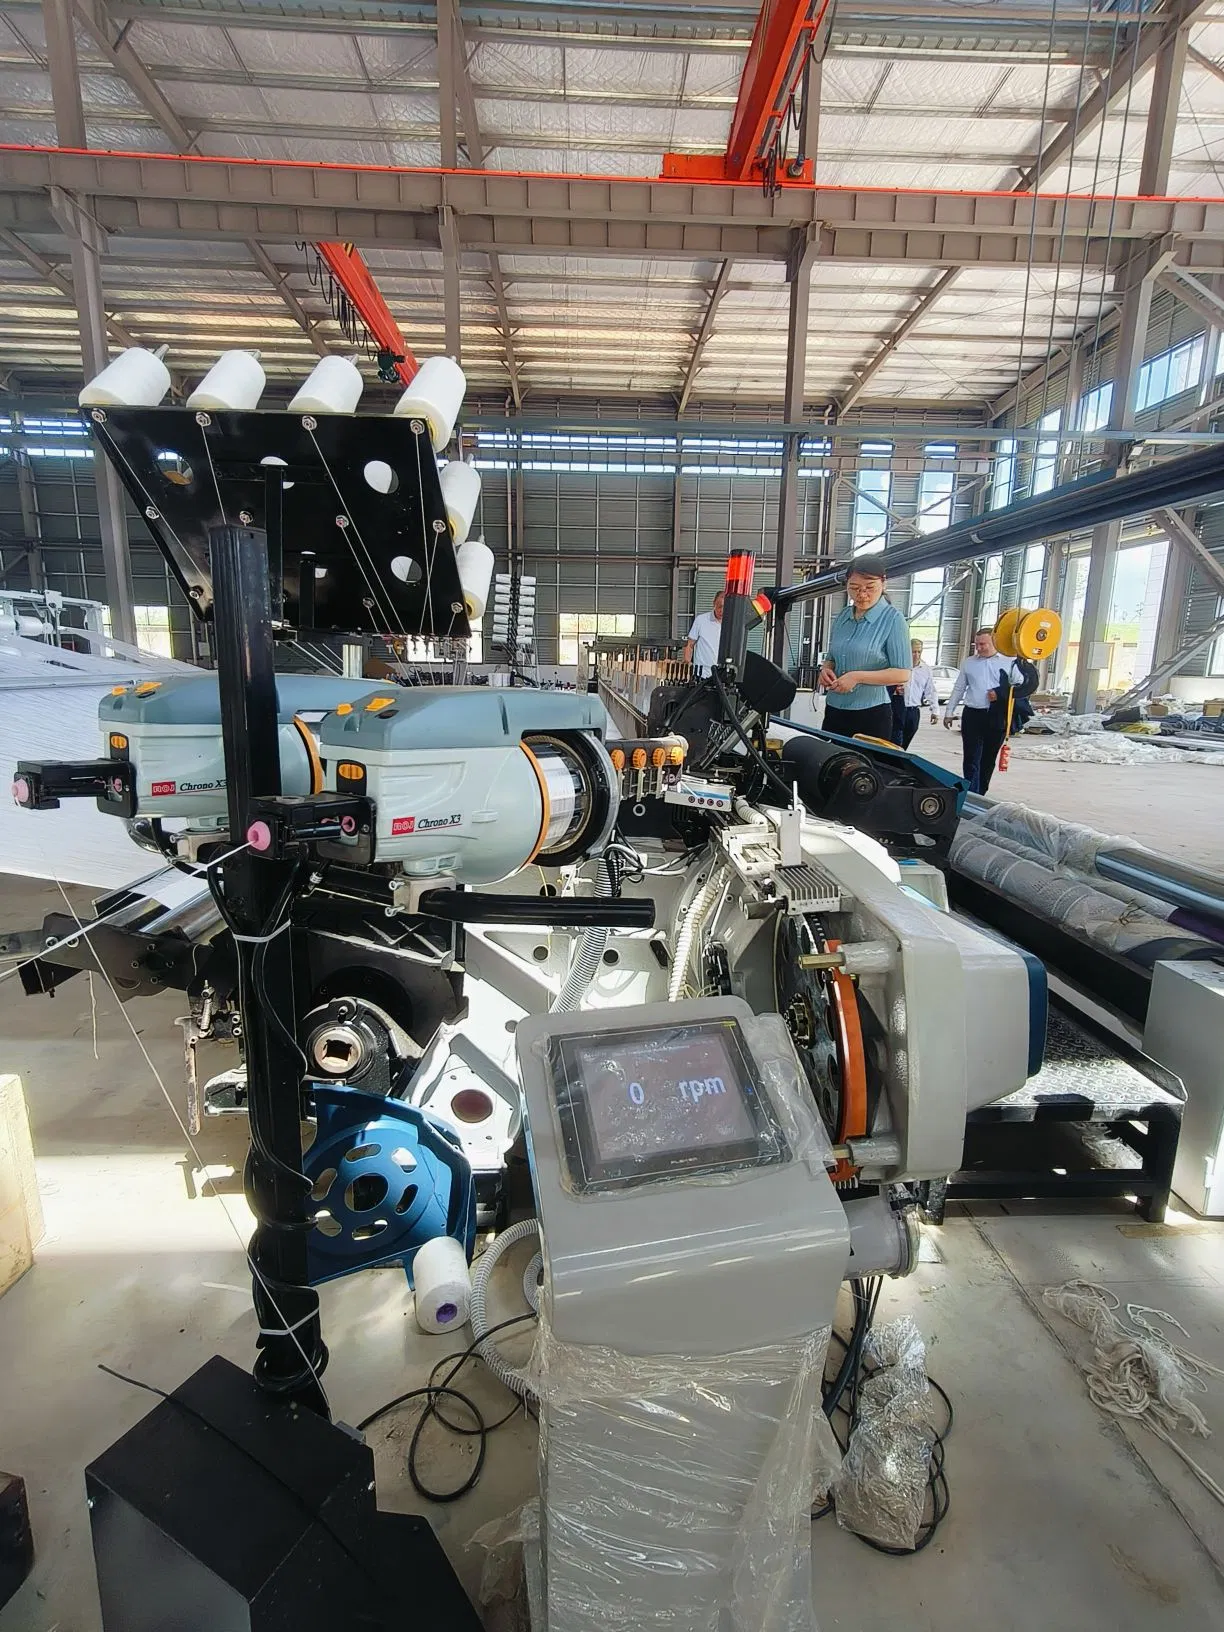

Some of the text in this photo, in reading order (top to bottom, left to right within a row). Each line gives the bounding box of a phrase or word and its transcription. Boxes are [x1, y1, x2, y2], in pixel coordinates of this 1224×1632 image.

[180, 782, 213, 792] Chrono
[418, 818, 448, 829] Chrono
[449, 814, 462, 825] X3
[629, 1077, 727, 1105] 0 rpm
